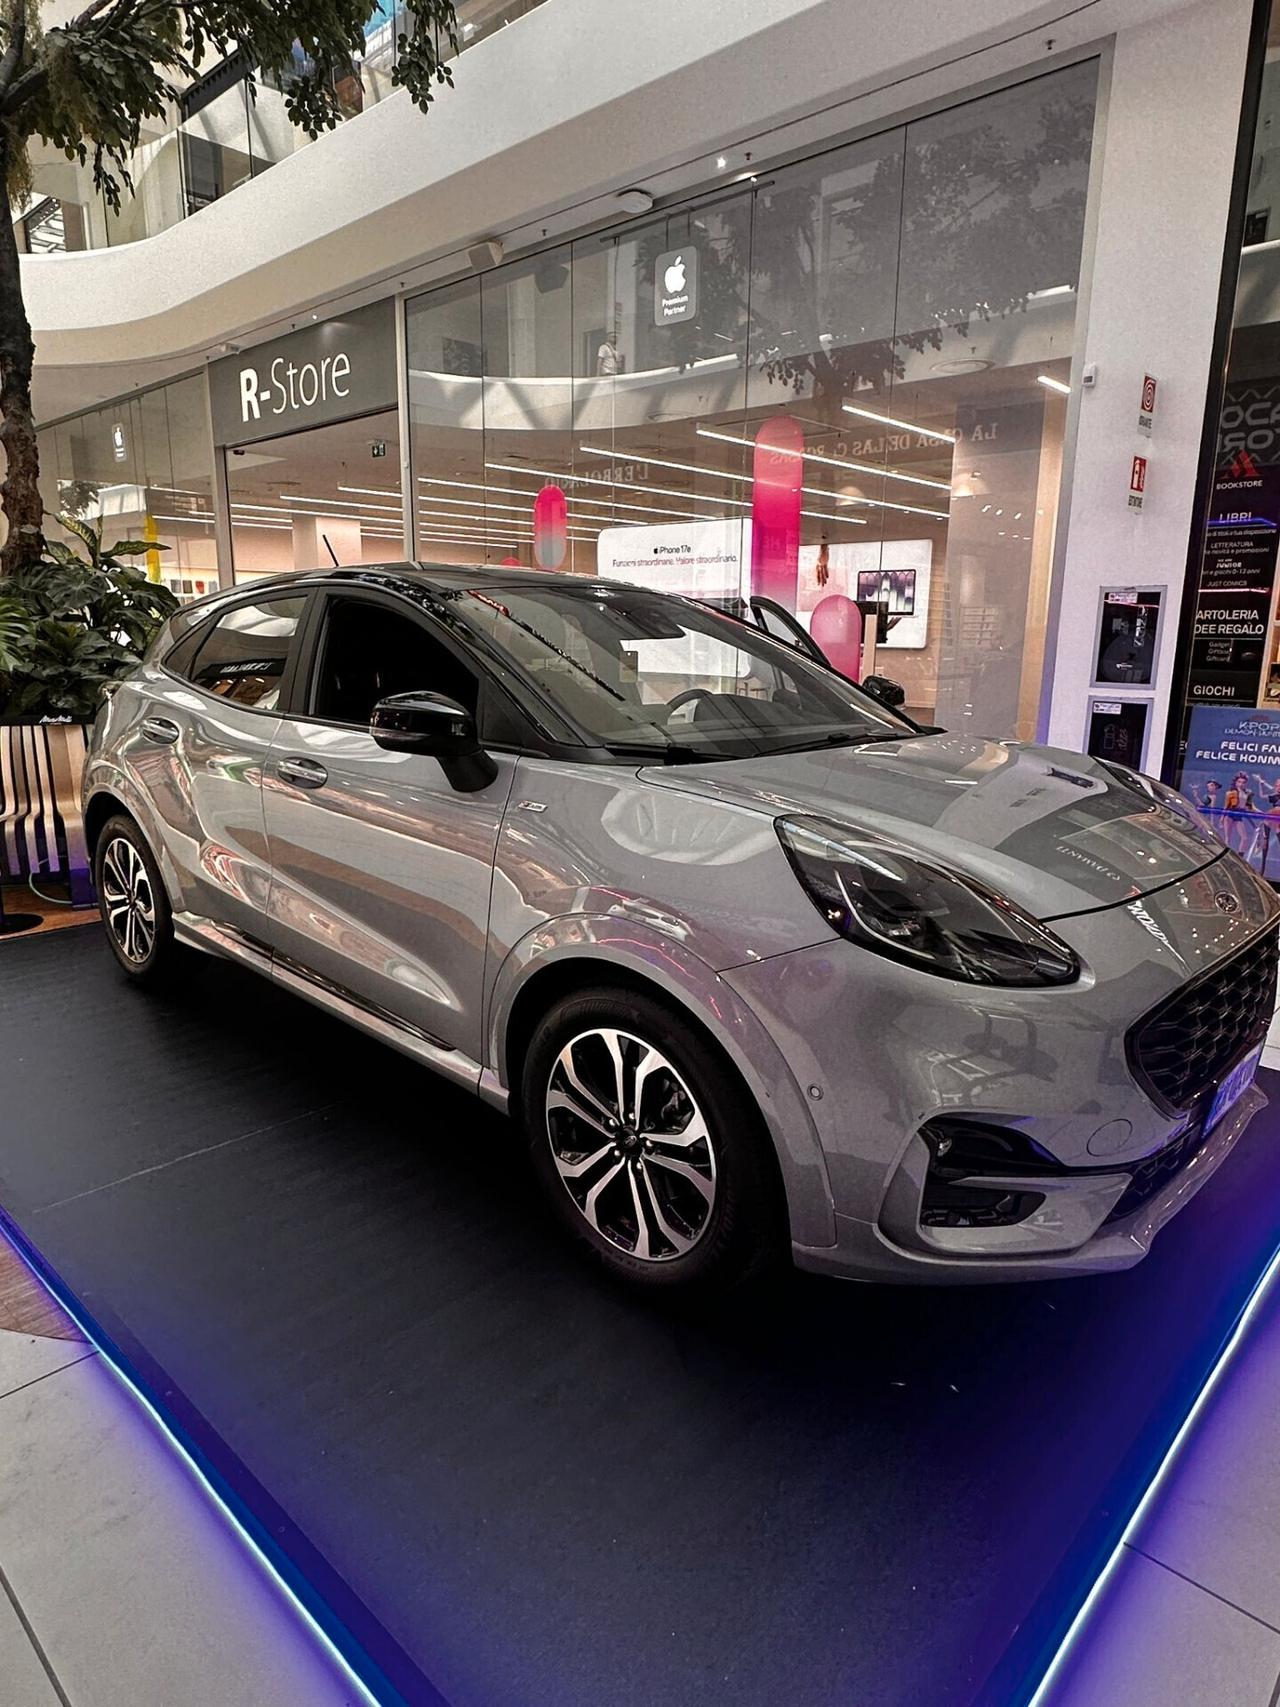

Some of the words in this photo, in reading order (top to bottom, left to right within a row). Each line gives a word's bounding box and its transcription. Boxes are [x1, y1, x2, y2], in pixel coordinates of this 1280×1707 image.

[662, 295, 689, 307] Premium
[663, 305, 687, 316] Partner
[240, 353, 351, 422] R-Store
[1216, 480, 1263, 490] BOOKSTORE
[1219, 512, 1252, 523] LIBRI
[1196, 609, 1259, 620] ARTOLERIA
[1218, 623, 1264, 634] REGALO
[1193, 685, 1235, 696] GIOCHI
[1220, 741, 1258, 751] FELICI
[1195, 750, 1237, 761] FELICE
